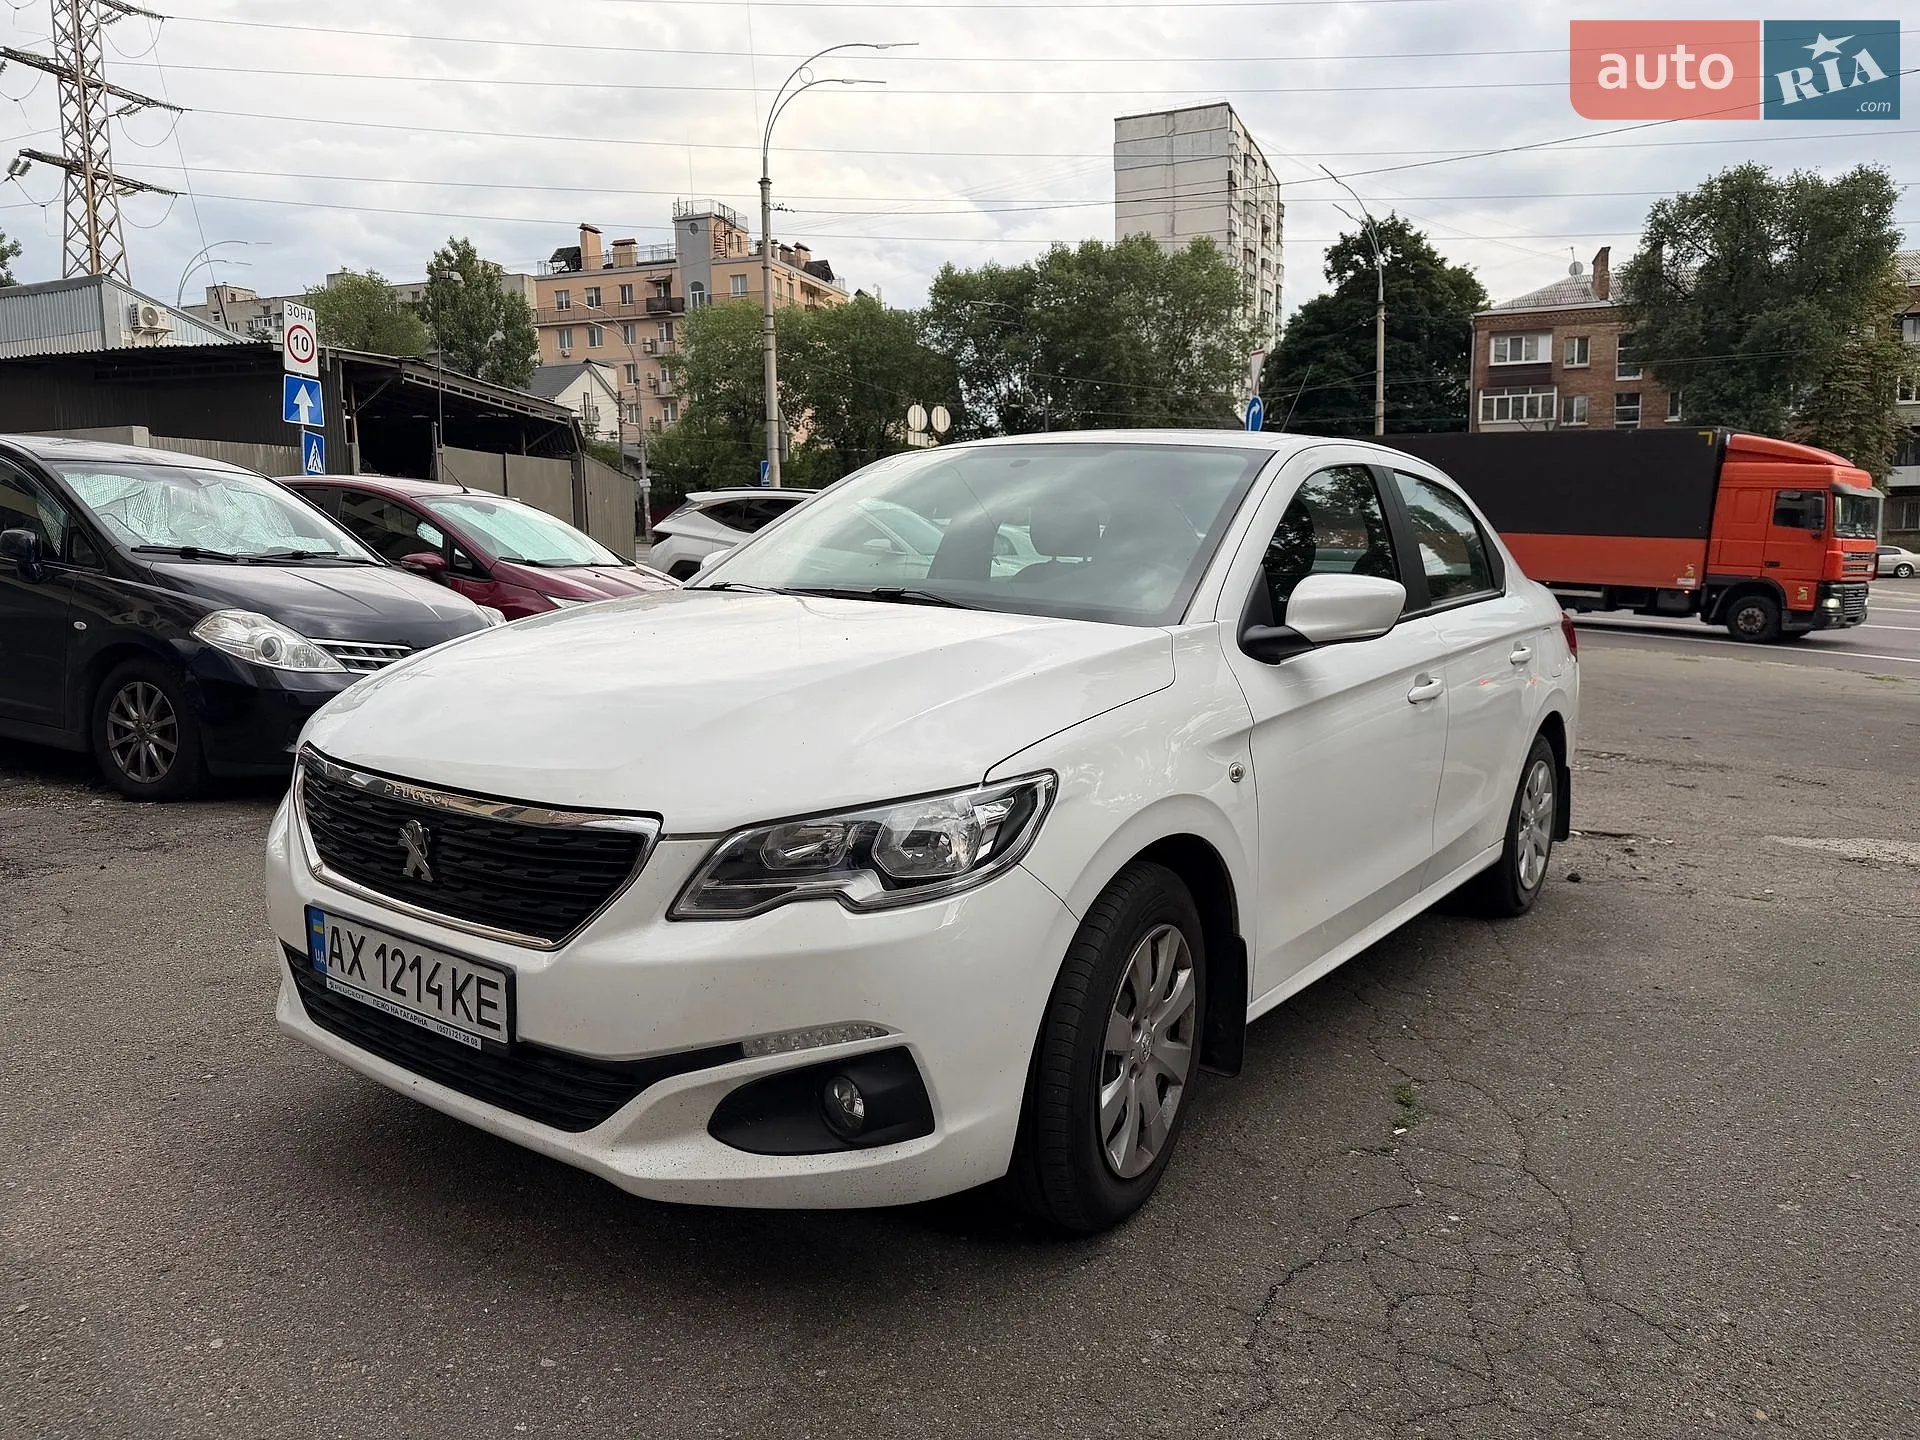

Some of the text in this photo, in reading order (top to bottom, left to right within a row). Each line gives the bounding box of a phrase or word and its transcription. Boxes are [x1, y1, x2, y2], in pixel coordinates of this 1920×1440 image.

[287, 304, 314, 322] ЗОНА
[293, 334, 309, 352] 10
[384, 783, 454, 807] PEUGEOT
[314, 947, 326, 965] UA
[328, 925, 367, 982] AX
